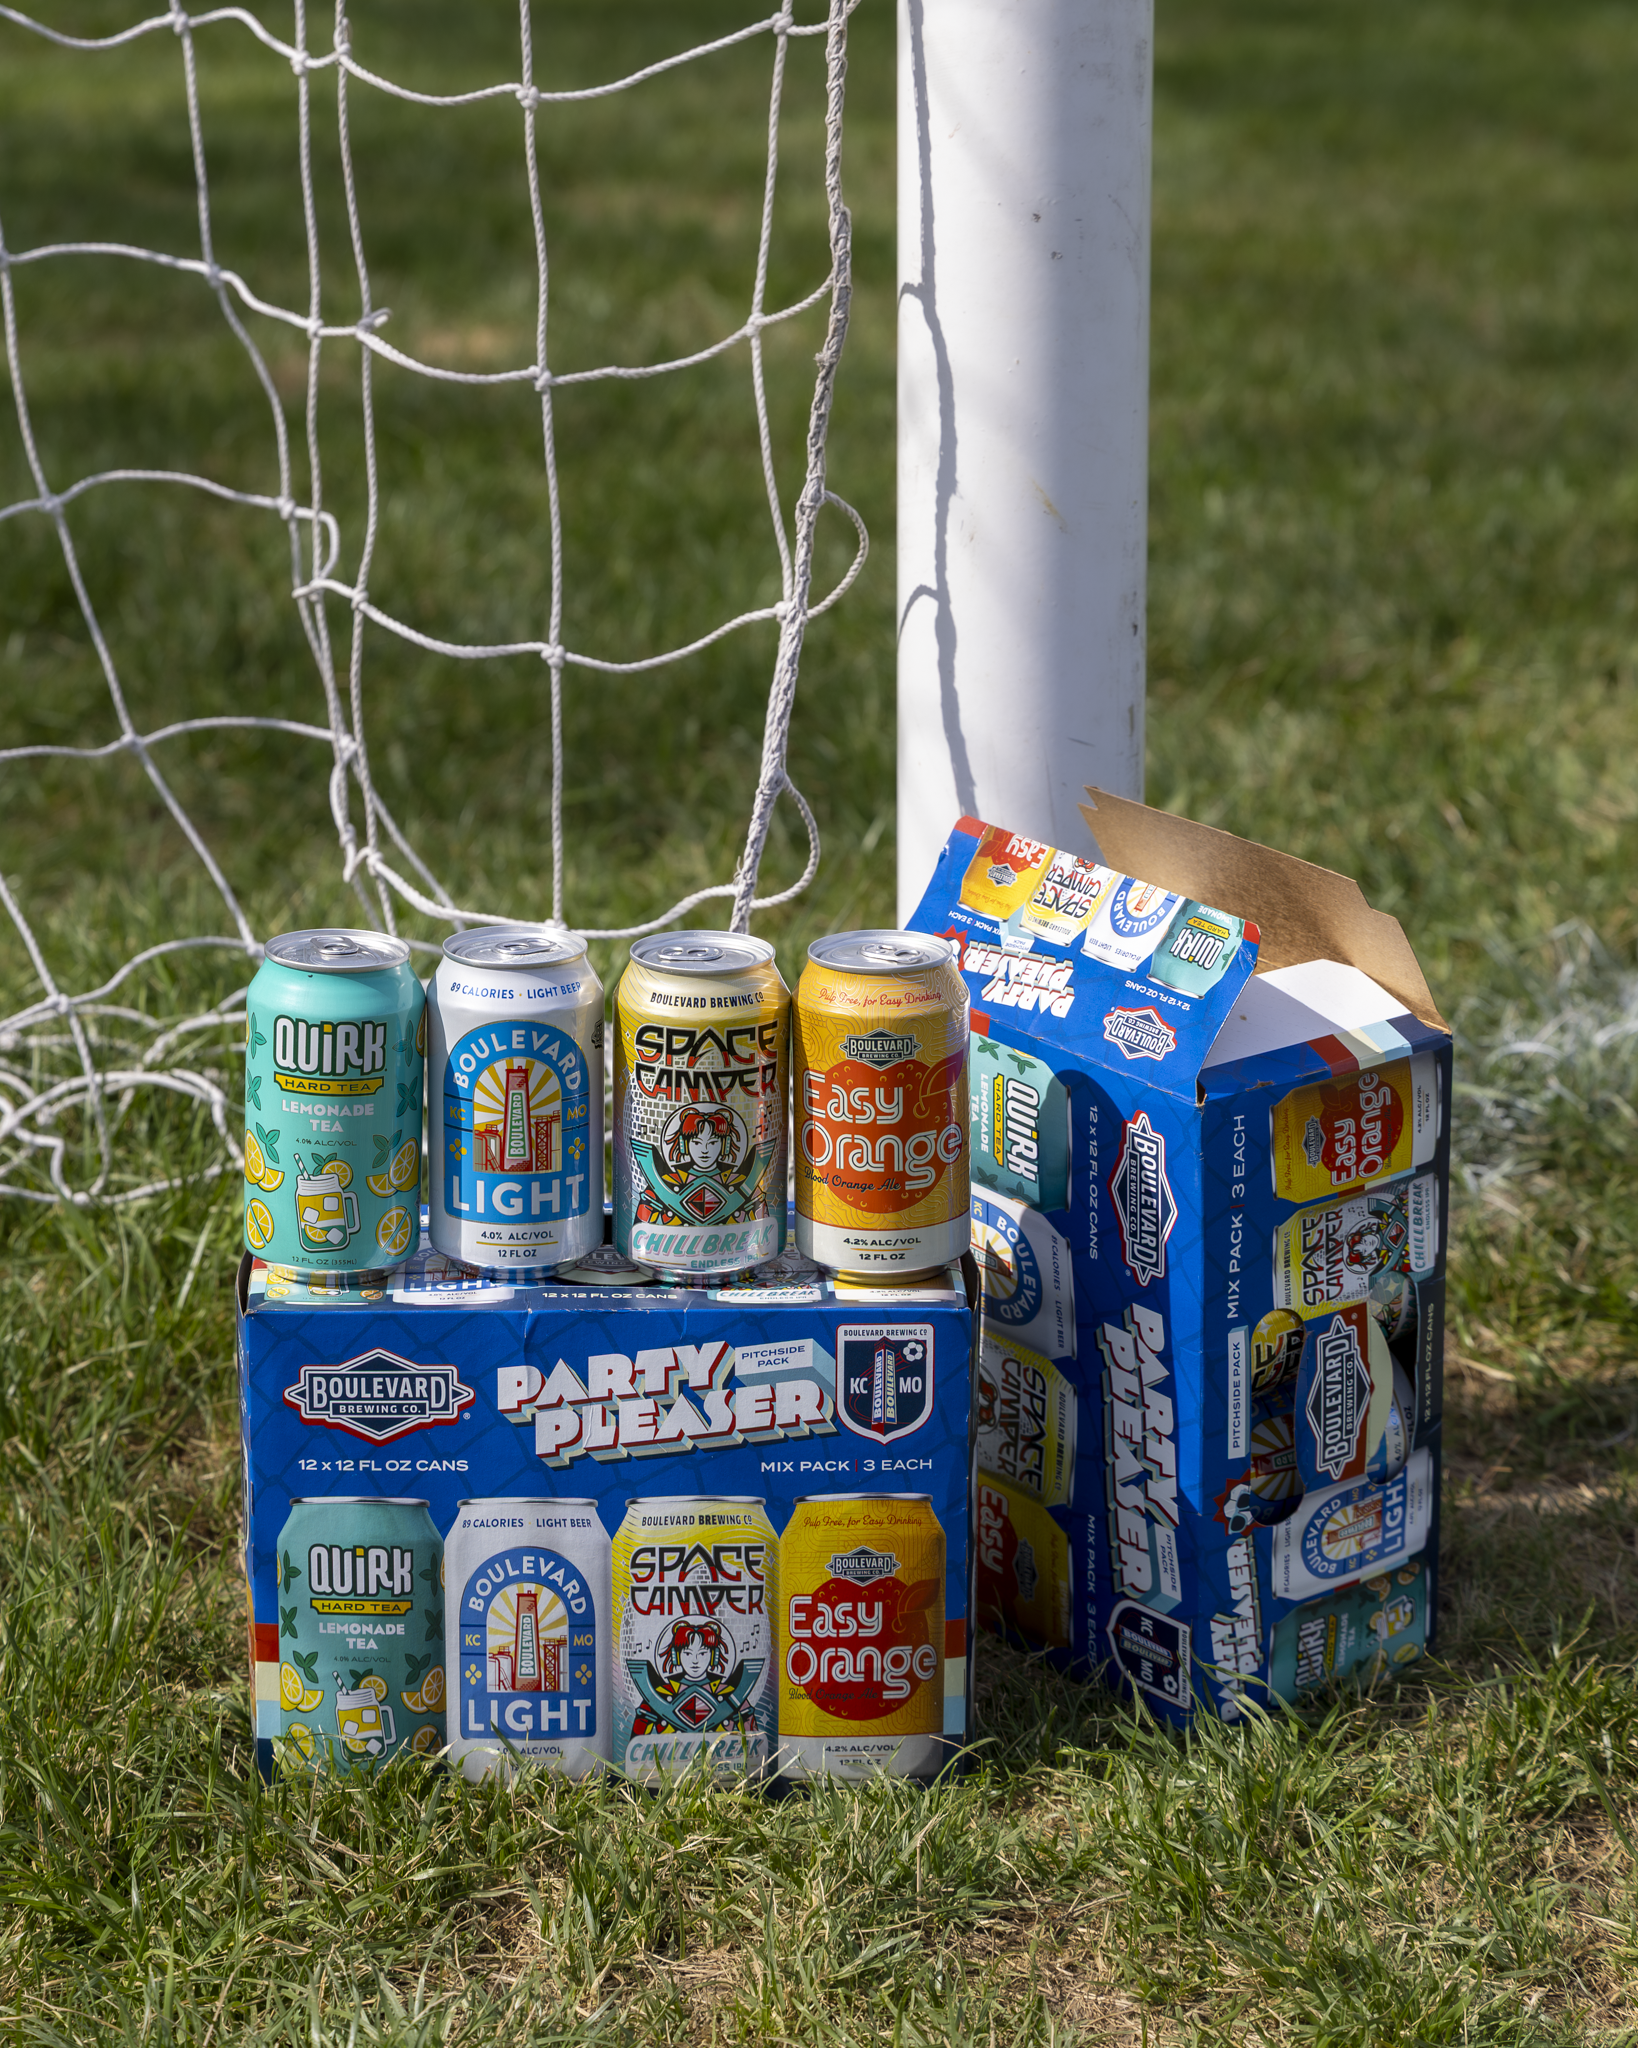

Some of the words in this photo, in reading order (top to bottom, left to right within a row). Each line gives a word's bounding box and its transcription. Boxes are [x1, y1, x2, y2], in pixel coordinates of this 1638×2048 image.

[1033, 882, 1092, 919] SPACE
[1114, 890, 1166, 933] BOULEVARD
[1198, 905, 1233, 925] LEMONADE
[964, 950, 1075, 990] PLEASER
[450, 982, 460, 992] 89
[462, 985, 514, 999] CALORIES
[527, 986, 558, 999] LIGHT
[561, 981, 582, 995] BEER
[651, 992, 707, 1008] BOULEVARD
[710, 993, 753, 1008] BREWING
[818, 987, 836, 1002] Pulp
[839, 992, 862, 1006] Free,
[863, 995, 878, 1008] for
[880, 994, 902, 1008] Easy
[904, 990, 942, 1004] Drinking
[982, 976, 1075, 1019] PARTY
[634, 1019, 779, 1068] SPACE
[850, 1038, 912, 1055] BOULEVARD
[1111, 1017, 1167, 1053] BOULEVARD
[453, 1029, 582, 1091] BOULEVARD
[285, 1078, 332, 1092] HARD
[337, 1083, 371, 1092] TEA
[635, 1061, 778, 1103] CAMPER
[803, 1069, 904, 1125] Easy
[282, 1099, 374, 1117] LEMONADE
[450, 1106, 466, 1121] KC
[566, 1104, 587, 1121] MO
[971, 1094, 980, 1122] TEA
[980, 1073, 989, 1154] LEMONADE
[1089, 1104, 1098, 1124] 12
[310, 1119, 344, 1133] TEA
[510, 1094, 524, 1156] BOULEVARD
[1089, 1126, 1098, 1136] x
[1358, 1072, 1392, 1178] Orange
[296, 1138, 312, 1146] 4.0%
[314, 1138, 358, 1147] ALC/VOL
[802, 1120, 963, 1190] Orange
[1089, 1140, 1098, 1158] 12
[1233, 1114, 1246, 1178] EACH
[1331, 1118, 1357, 1186] Easy
[804, 1166, 829, 1184] Blood
[832, 1175, 876, 1192] Orange
[878, 1178, 902, 1191] Ale
[1089, 1160, 1098, 1181] FL
[452, 1174, 584, 1216] LIGHT
[1089, 1184, 1098, 1210] OZ
[1134, 1136, 1158, 1265] BOULEVARD
[1232, 1183, 1245, 1198] 3
[974, 1200, 983, 1218] KC
[480, 1231, 502, 1240] 4.0%
[508, 1230, 554, 1241] ALC/VOL
[632, 1224, 774, 1256] CHILLBREAK
[843, 1237, 868, 1246] 4.2%
[870, 1236, 922, 1246] ALC/VOL
[1089, 1212, 1098, 1260] CANS
[1412, 1182, 1426, 1270] CHILLBREAK
[498, 1250, 508, 1258] 12
[510, 1250, 522, 1258] FL
[523, 1249, 537, 1258] OZ
[1228, 1212, 1243, 1272] PACK
[1326, 1208, 1344, 1302] CAMPER
[690, 1256, 741, 1268] ENDLESS
[996, 1215, 1037, 1320] BOULEVARD
[1302, 1214, 1324, 1307] SPACE
[1226, 1278, 1240, 1319] MIX
[742, 1345, 806, 1360] PITCHSIDE
[757, 1358, 790, 1368] PACK
[1232, 1342, 1242, 1378] PACK
[1346, 1357, 1354, 1375] CO.
[497, 1340, 726, 1411] PARTY
[850, 1378, 868, 1394] KC
[873, 1355, 883, 1419] BOULEVARD
[886, 1354, 896, 1419] BOULEVARD
[899, 1376, 923, 1394] MO
[312, 1376, 446, 1408] BOULEVARD
[1325, 1338, 1350, 1460] BOULEVARD
[1346, 1378, 1354, 1431] BREWING
[339, 1404, 398, 1414] BREWING
[402, 1404, 421, 1414] CO.
[536, 1380, 825, 1455] PLEASER
[1131, 1302, 1180, 1527] PARTY
[1232, 1382, 1242, 1449] PITCHSIDE
[1020, 1366, 1046, 1492] SPACE
[298, 1459, 318, 1471] 12
[321, 1462, 332, 1471] x
[335, 1460, 354, 1472] 12
[359, 1460, 382, 1472] FL
[385, 1460, 412, 1472] OZ
[416, 1460, 469, 1472] CANS
[761, 1462, 794, 1472] MIX
[800, 1460, 850, 1472] PACK
[863, 1460, 876, 1472] 3
[882, 1458, 933, 1471] EACH
[1102, 1322, 1152, 1594] PLEASER
[462, 1520, 471, 1528] 89
[473, 1518, 524, 1528] CALORIES
[536, 1518, 568, 1528] LIGHT
[570, 1518, 592, 1528] BEER
[642, 1515, 695, 1526] BOULEVARD
[698, 1514, 742, 1526] BREWING
[803, 1516, 820, 1529] Pulp
[822, 1516, 846, 1528] Free,
[846, 1516, 861, 1528] for
[862, 1514, 884, 1528] Easy
[886, 1514, 922, 1526] Drinking
[1306, 1498, 1342, 1574] BOULEVARD
[630, 1542, 765, 1583] SPACE
[835, 1557, 891, 1574] BOULEVARD
[1160, 1544, 1170, 1576] PACK
[1166, 1534, 1178, 1593] PITCHSIDE
[468, 1556, 587, 1614] BOULEVARD
[630, 1585, 764, 1616] CAMPER
[322, 1602, 365, 1611] HARD
[370, 1604, 402, 1612] TEA
[788, 1594, 882, 1638] Easy
[1226, 1538, 1260, 1675] PLEASER
[318, 1622, 405, 1636] LEMONADE
[465, 1634, 481, 1646] KC
[573, 1634, 594, 1646] MO
[1140, 1616, 1154, 1638] KC
[346, 1638, 378, 1650] TEA
[521, 1616, 534, 1676] BOULEVARD
[786, 1642, 938, 1700] Orange
[1140, 1658, 1154, 1683] MO
[788, 1688, 812, 1700] Blood
[816, 1688, 854, 1702] Orange
[858, 1688, 878, 1700] Ale
[468, 1699, 592, 1732] LIGHT
[520, 1746, 562, 1755] ALC/VOL
[826, 1744, 848, 1752] 4.2%
[850, 1744, 896, 1752] ALC/VOL
